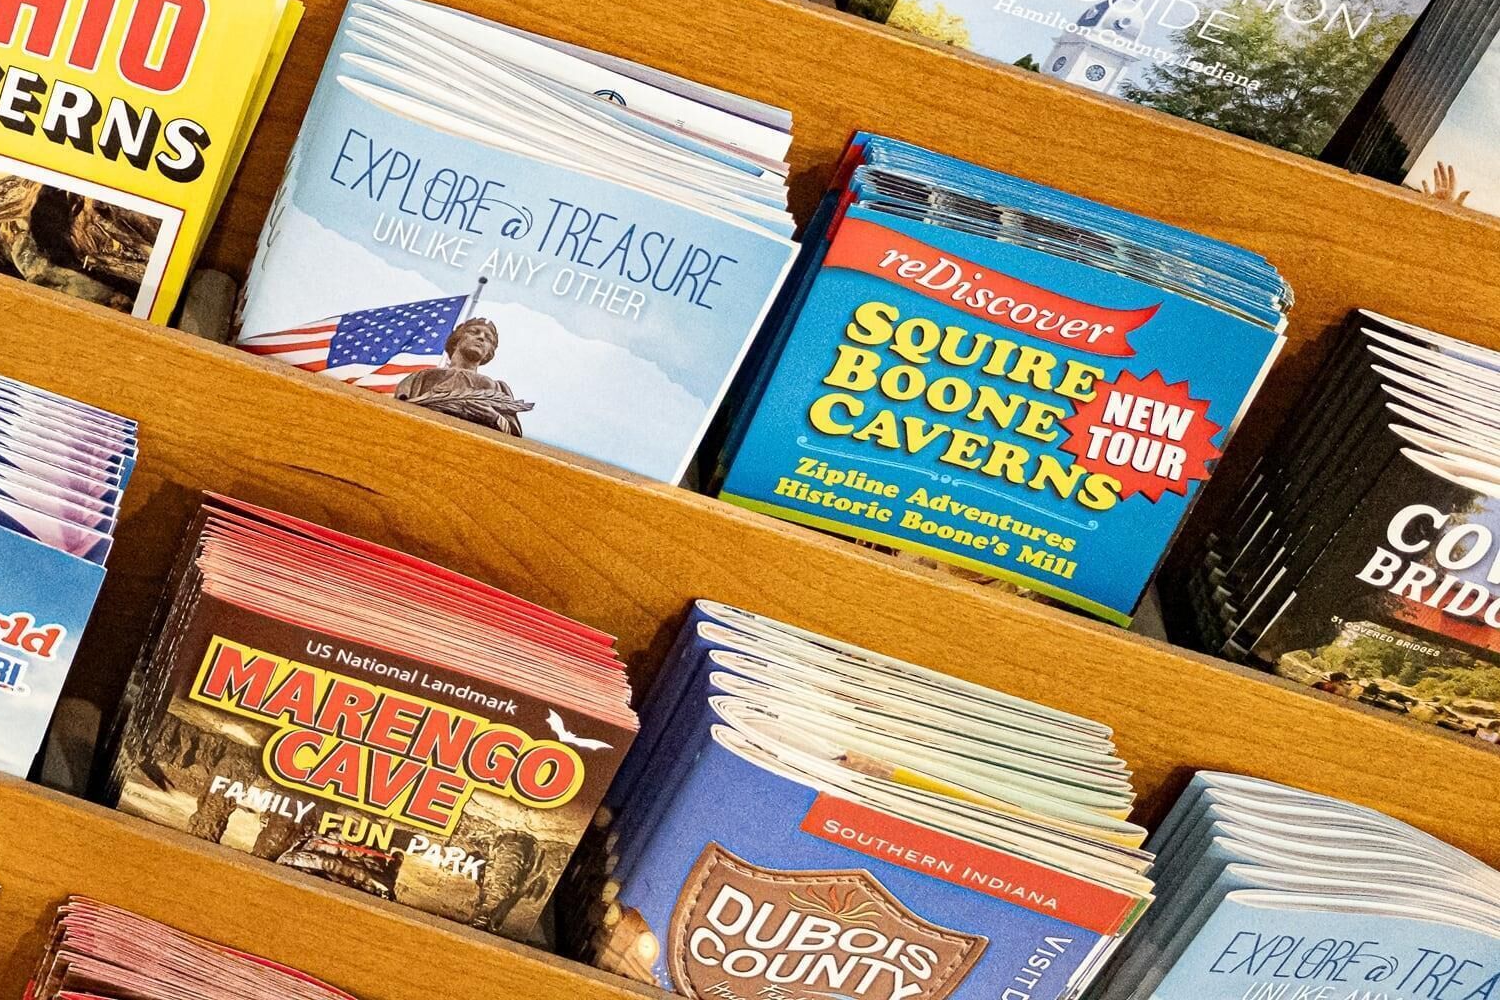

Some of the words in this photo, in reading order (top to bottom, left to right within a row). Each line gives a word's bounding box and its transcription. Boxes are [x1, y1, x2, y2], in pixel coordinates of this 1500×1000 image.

[1178, 55, 1261, 92] Indiana
[330, 128, 505, 235] EXPLORE
[538, 198, 738, 310] TREASURE
[373, 213, 475, 269] UNLIKE
[479, 247, 547, 286] ANY
[552, 273, 647, 322] OTHER
[878, 245, 1117, 347] reDiscover
[822, 344, 1067, 444] BOONE
[846, 301, 1105, 405] SQUIRE
[808, 393, 1124, 512] CAVERNS
[1088, 425, 1188, 481] TOUR
[1102, 389, 1195, 441] NEW
[773, 477, 894, 524] Historic
[899, 509, 1010, 557] Boone's
[1015, 545, 1078, 580] Mill
[794, 457, 901, 499] Zipline
[906, 485, 1077, 554] Adventures
[305, 638, 332, 660] US
[335, 648, 419, 685] National
[421, 672, 518, 717] Landmark
[1345, 621, 1394, 643] COVERED
[1395, 639, 1440, 657] BRIDGES
[201, 641, 578, 804] MARENGO
[208, 774, 318, 824] FAMILY
[317, 811, 394, 852] FUN
[406, 834, 486, 882] PARK
[270, 729, 468, 830] CAVE
[822, 818, 954, 875] SOUTHERN
[961, 865, 1058, 911] INDIANA
[689, 926, 923, 1000] COUNTY
[705, 883, 939, 981] DUBOIS
[1210, 931, 1379, 982] EXPLORE
